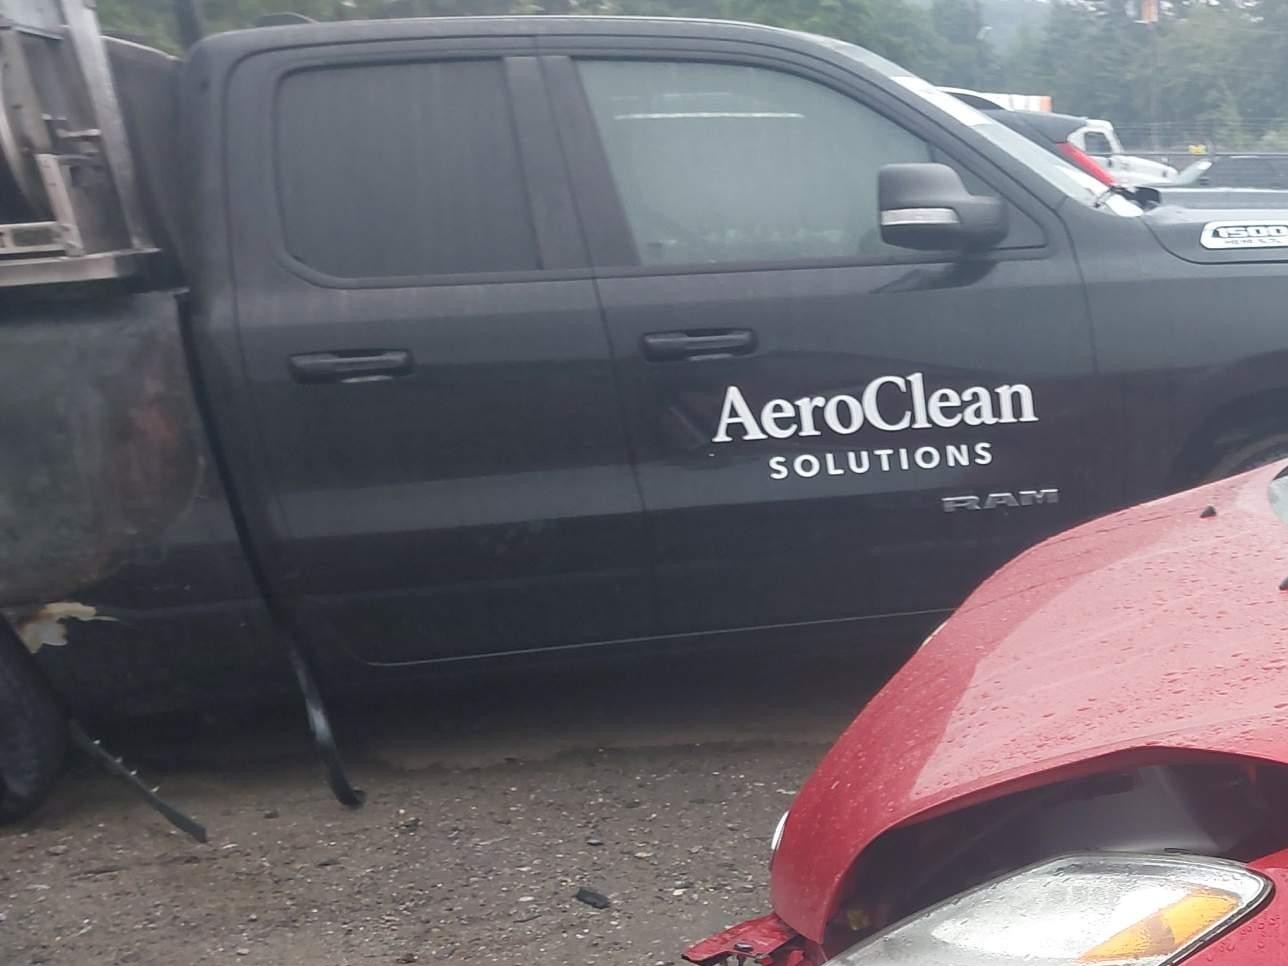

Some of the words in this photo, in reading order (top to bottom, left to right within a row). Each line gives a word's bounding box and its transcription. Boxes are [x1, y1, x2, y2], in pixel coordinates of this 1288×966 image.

[711, 372, 1039, 443] AeroClean
[768, 442, 993, 480] SOLUTIONS
[941, 488, 1059, 513] RAM
